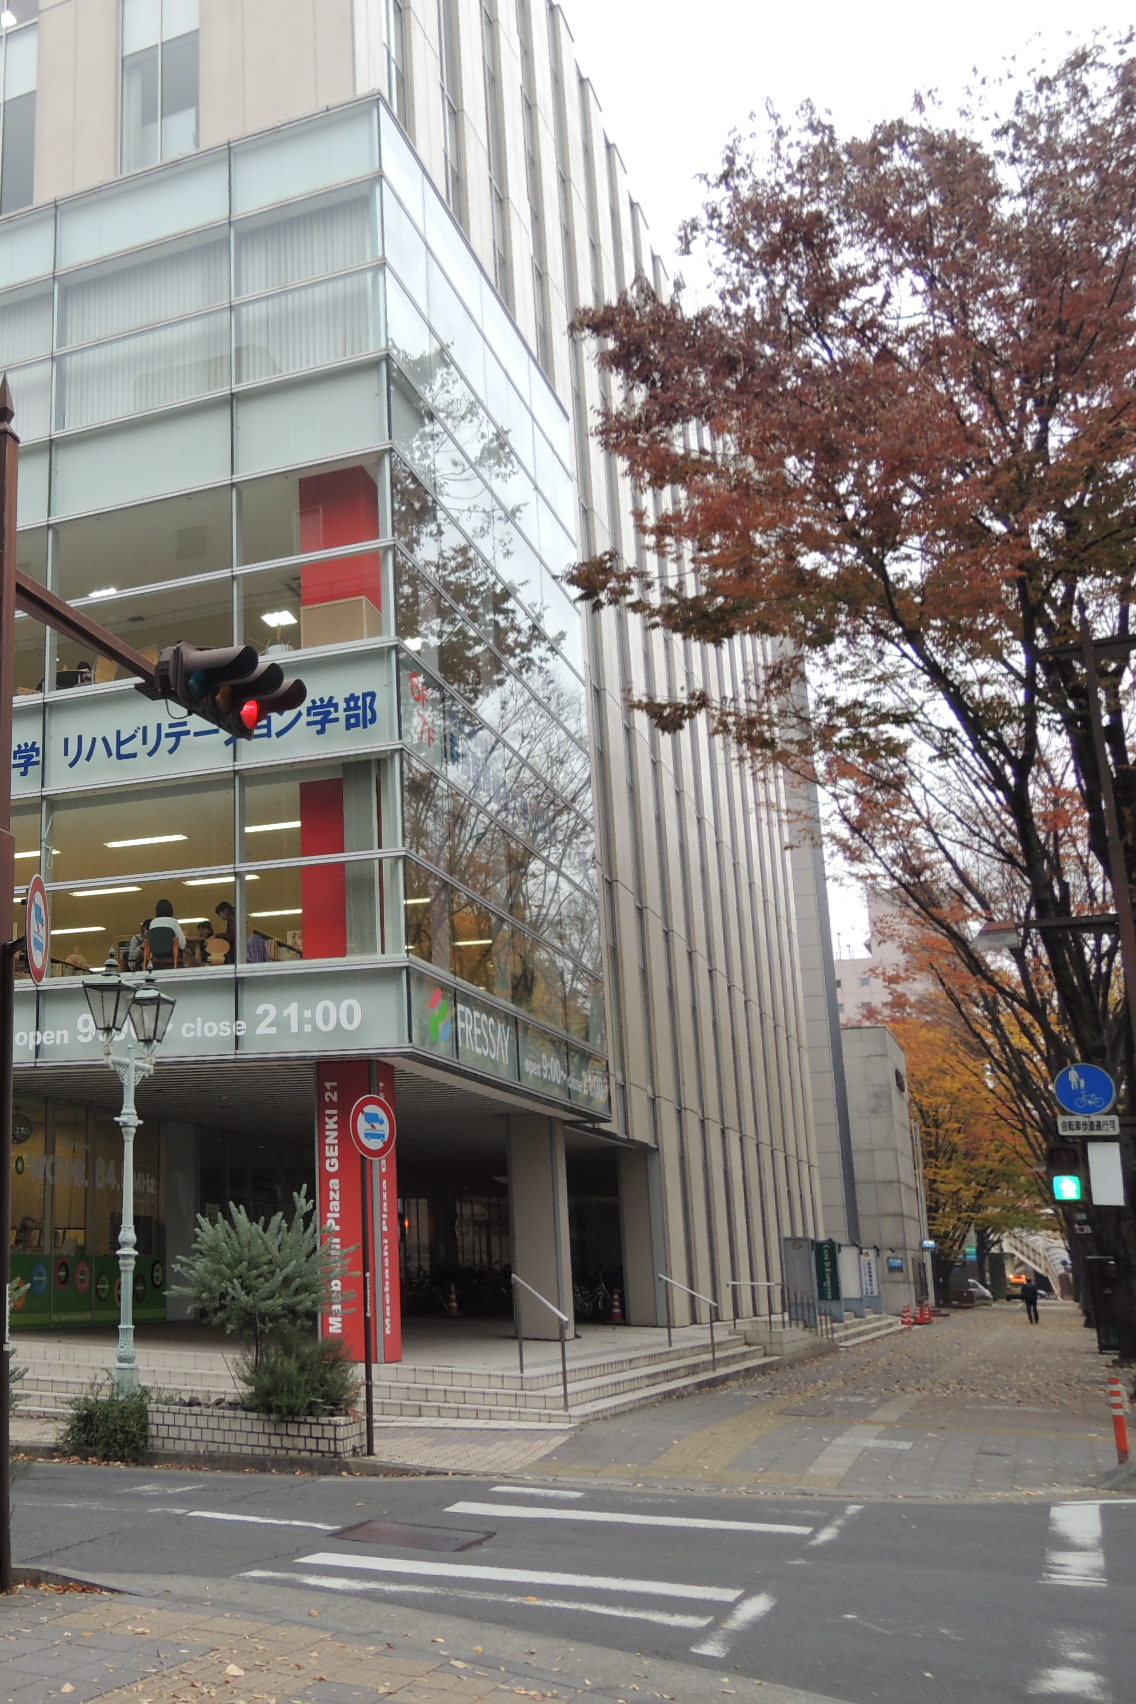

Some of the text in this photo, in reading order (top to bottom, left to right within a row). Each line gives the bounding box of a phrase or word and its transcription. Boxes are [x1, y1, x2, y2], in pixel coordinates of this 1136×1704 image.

[63, 690, 378, 769] リハビリテーョン学部
[15, 1026, 69, 1050] open
[181, 1016, 247, 1039] close
[255, 998, 363, 1036] 21:00
[456, 1003, 511, 1065] FRESSAY
[324, 1081, 338, 1103] 21
[324, 1109, 339, 1172] GENKI
[326, 1178, 341, 1231] Plaza
[380, 1181, 389, 1232] Plaza
[381, 1238, 392, 1335] Maebashi
